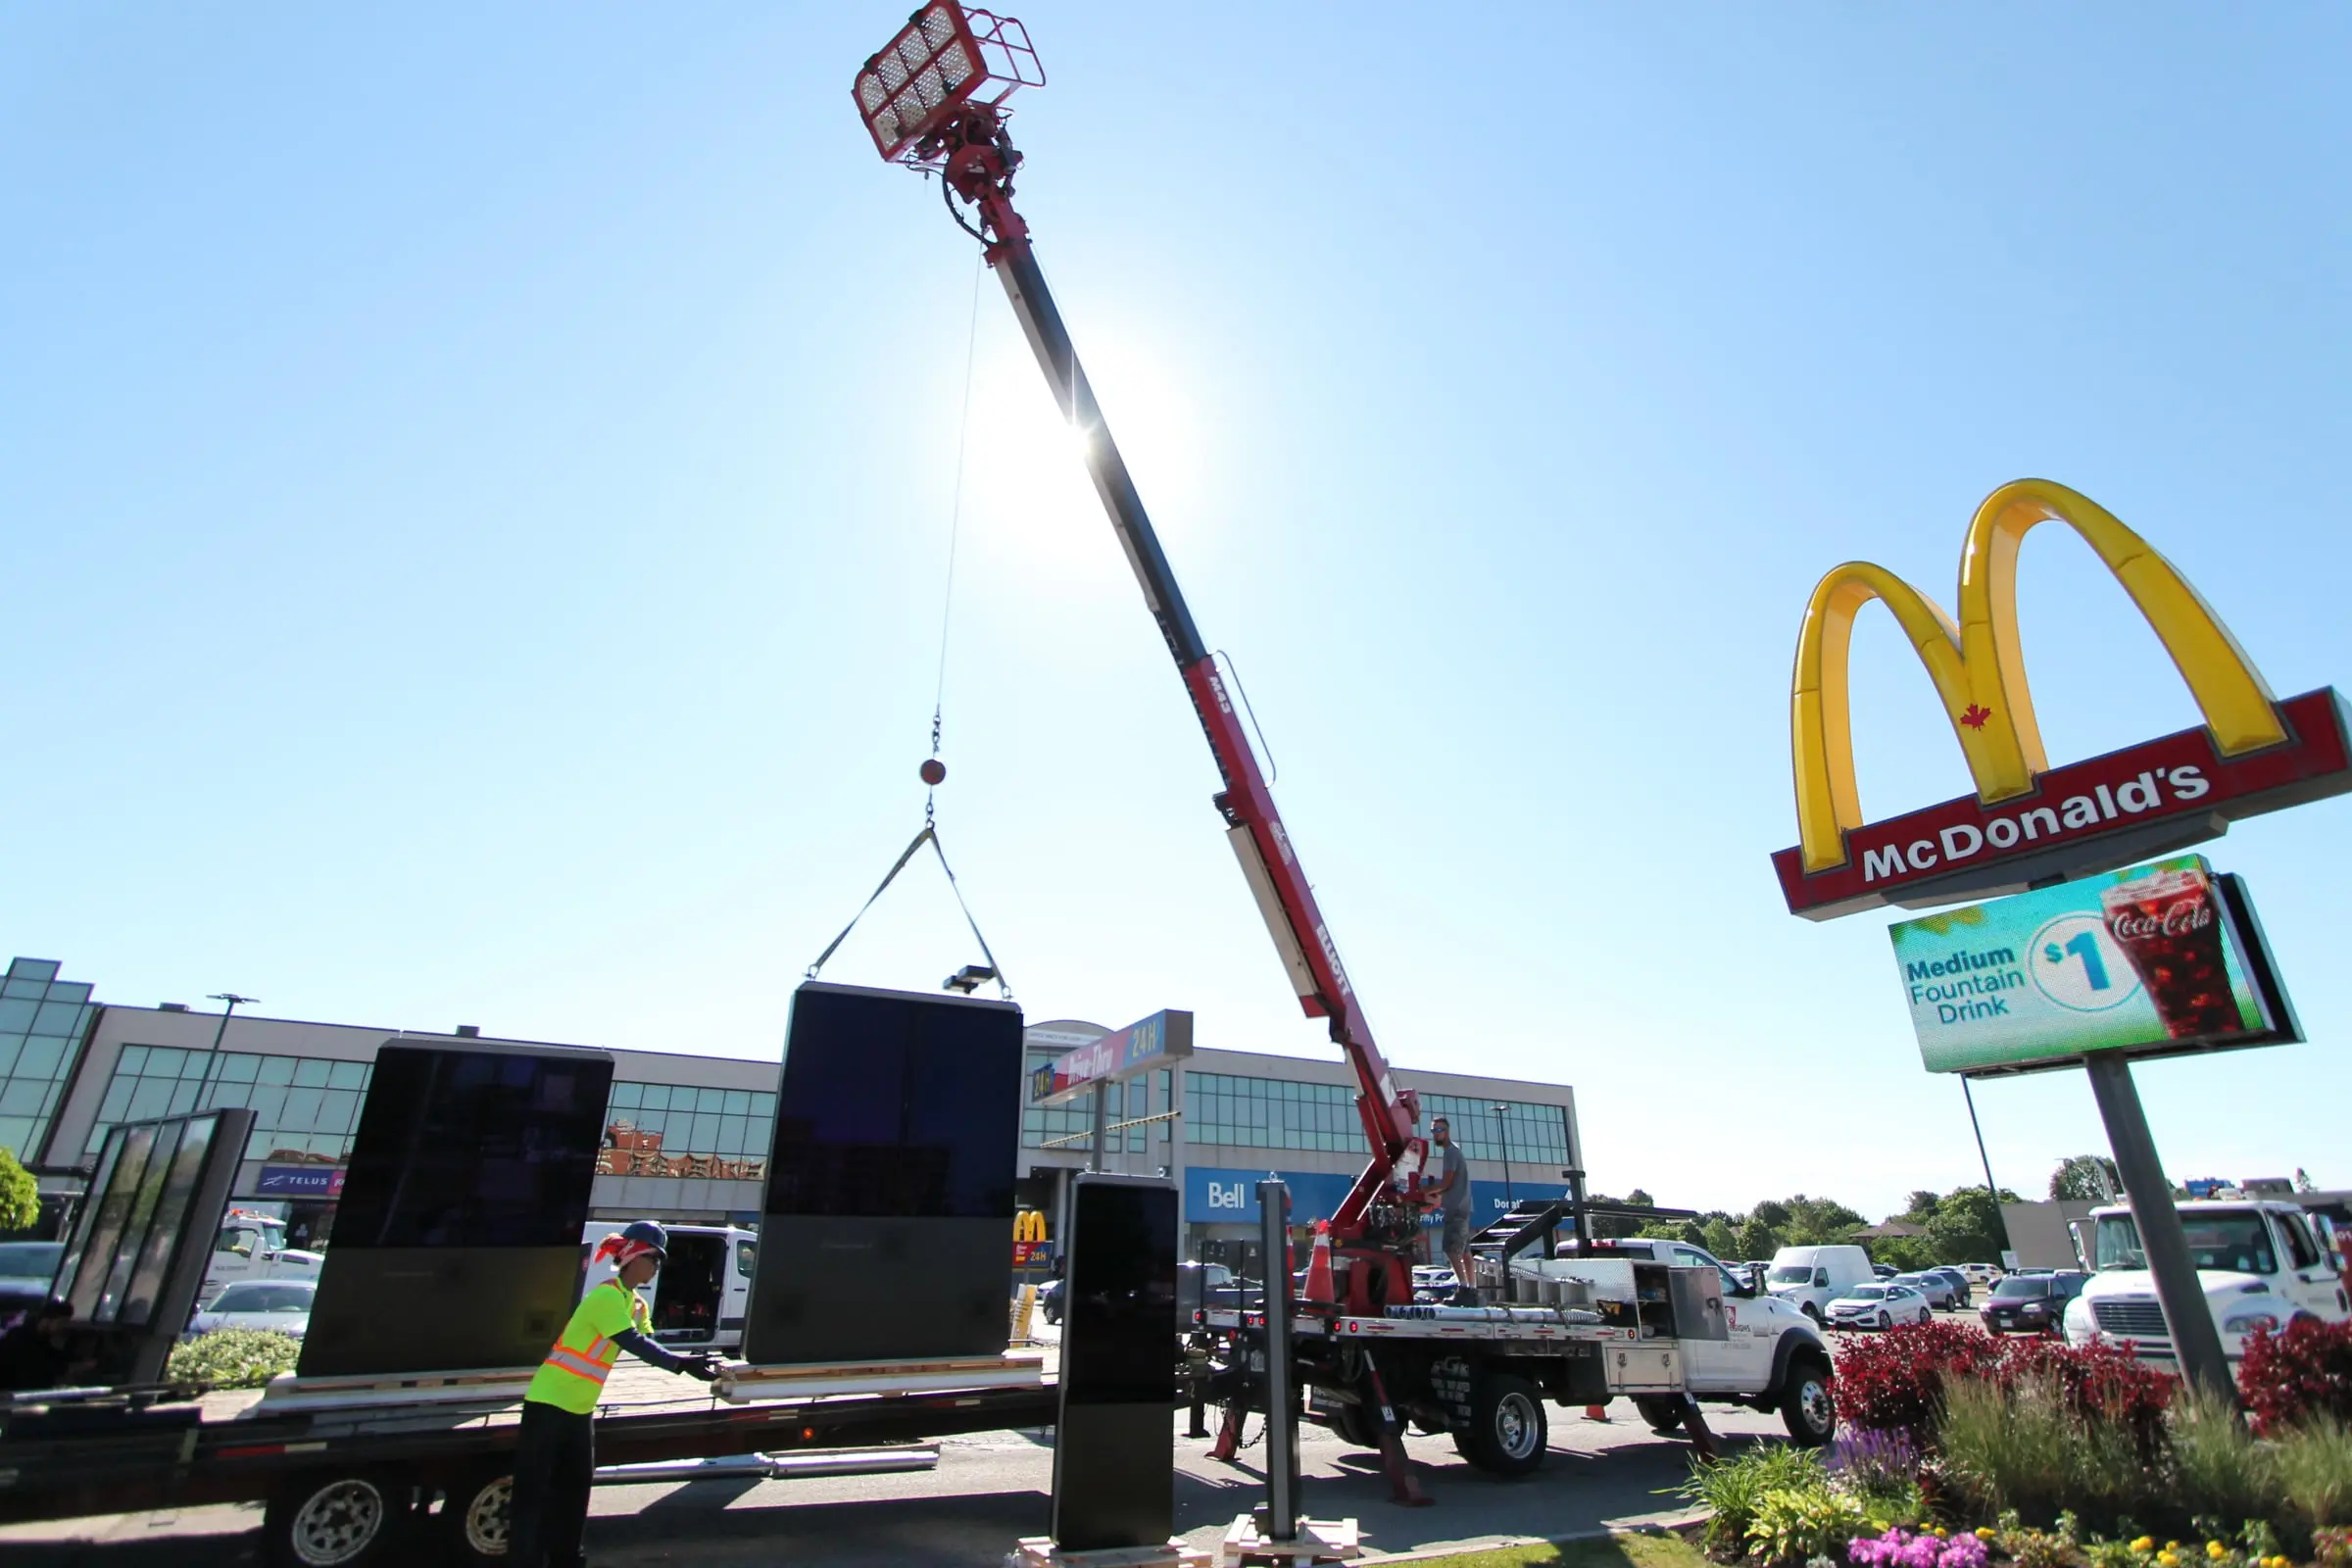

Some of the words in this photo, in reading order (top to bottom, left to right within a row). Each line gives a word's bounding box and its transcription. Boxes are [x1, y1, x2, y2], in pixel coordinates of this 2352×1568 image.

[1863, 765, 2210, 882] McDonald's
[2112, 897, 2213, 943] Coca-Cola
[1316, 923, 1350, 997] ELLIOTT
[1906, 947, 2017, 981] Medium
[2044, 930, 2112, 991] $1
[1910, 967, 2026, 1005] Fountain
[1936, 994, 2010, 1025] Drink
[1132, 1021, 1158, 1057] 24H
[289, 1176, 329, 1186] TELUS
[1207, 1182, 1245, 1208] Bell
[1030, 1250, 1048, 1262] 24H
